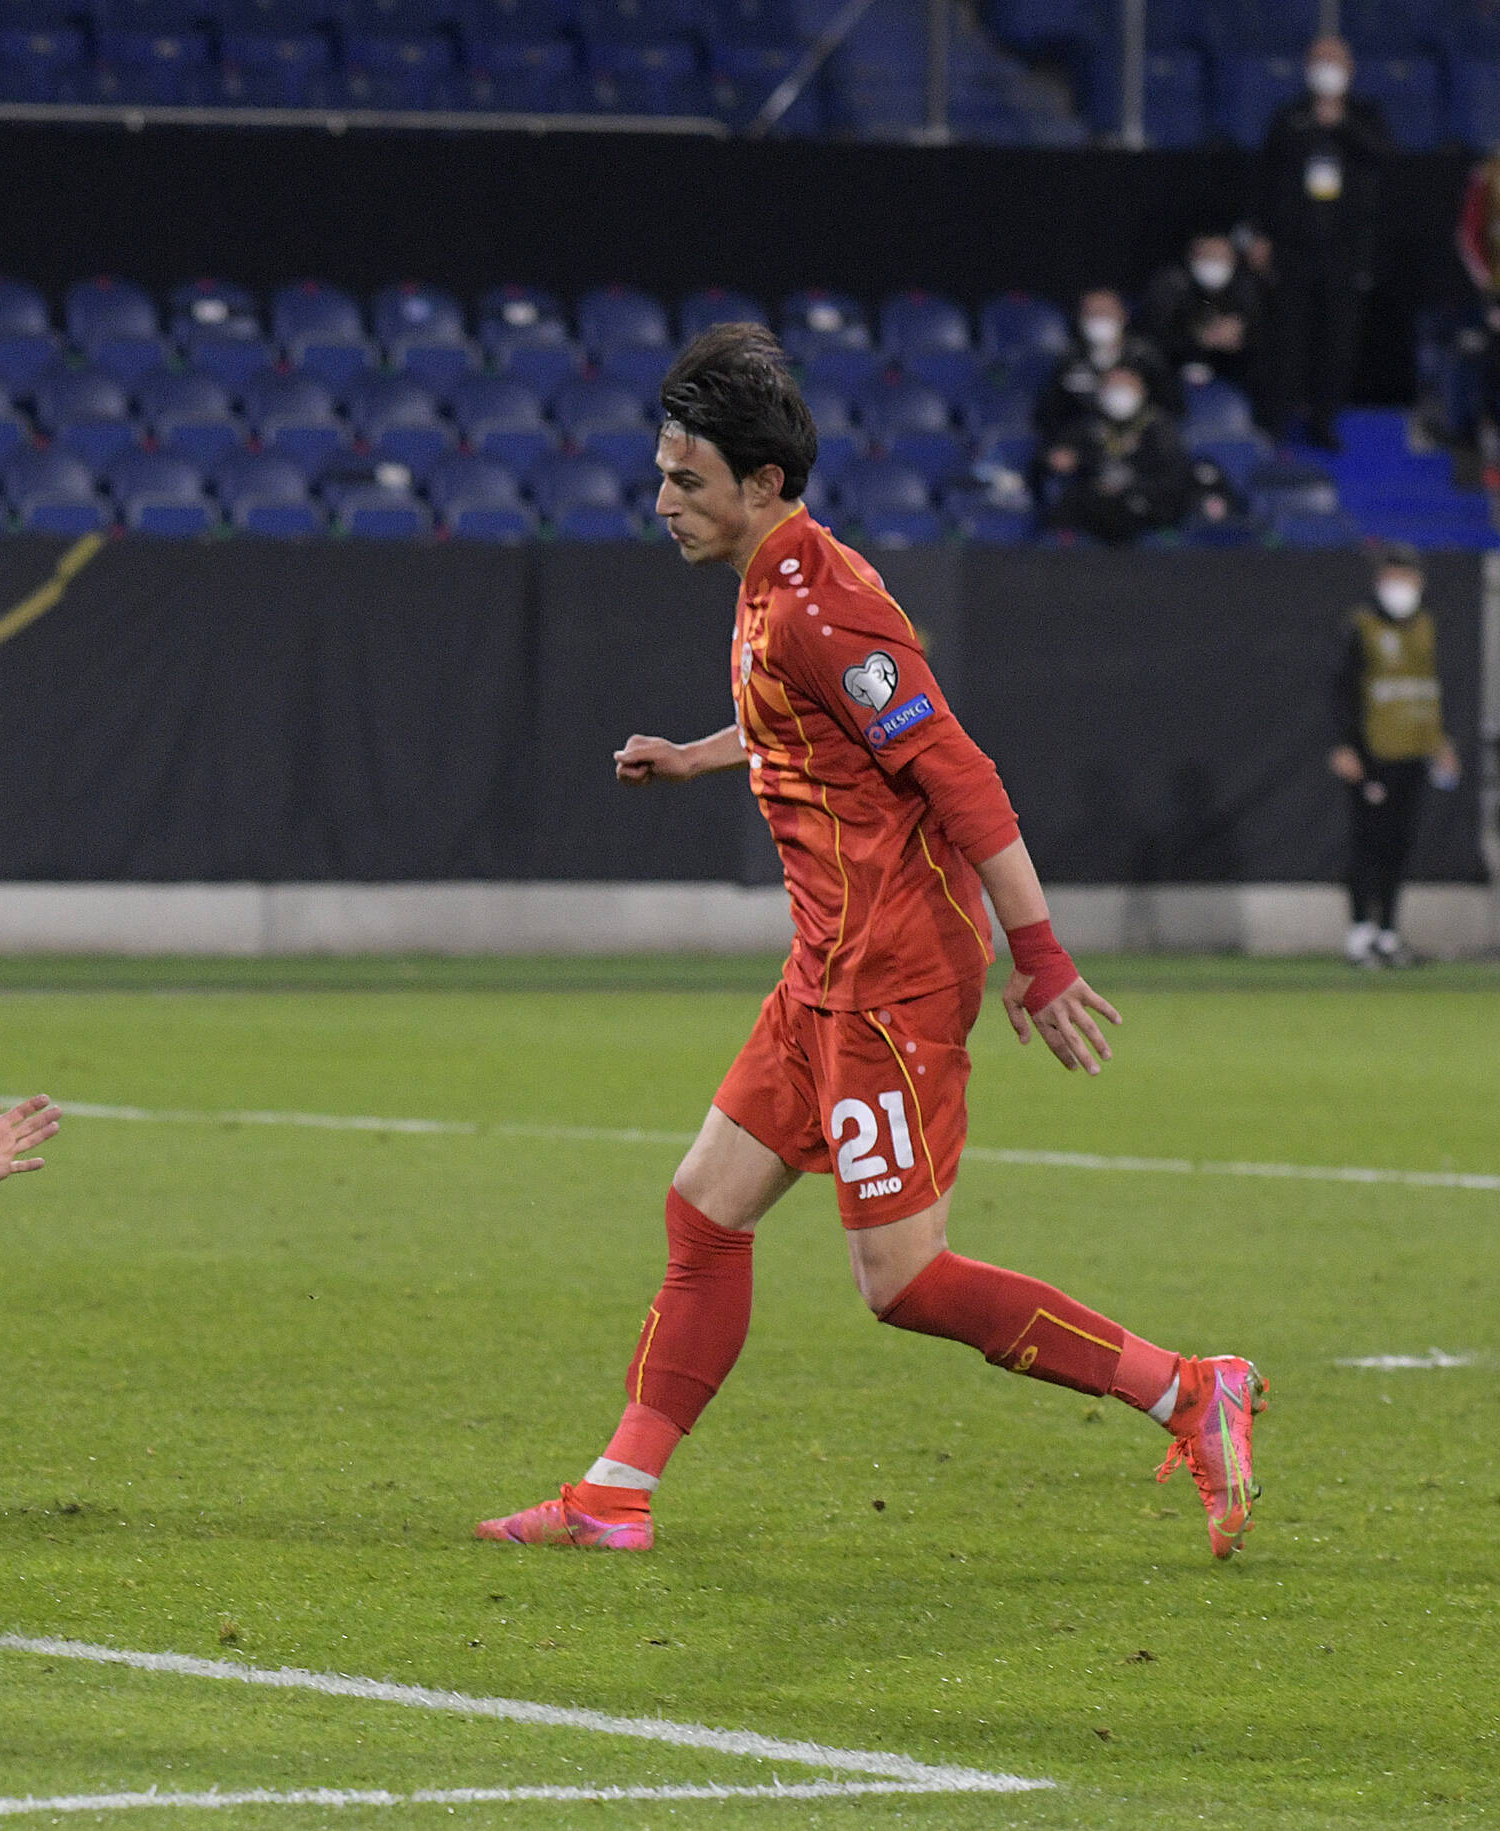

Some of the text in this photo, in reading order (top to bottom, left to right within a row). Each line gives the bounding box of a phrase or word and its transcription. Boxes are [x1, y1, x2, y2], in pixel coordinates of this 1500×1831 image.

[883, 699, 930, 734] RESPECT
[831, 1090, 914, 1183] 21
[859, 1176, 902, 1199] JAKO
